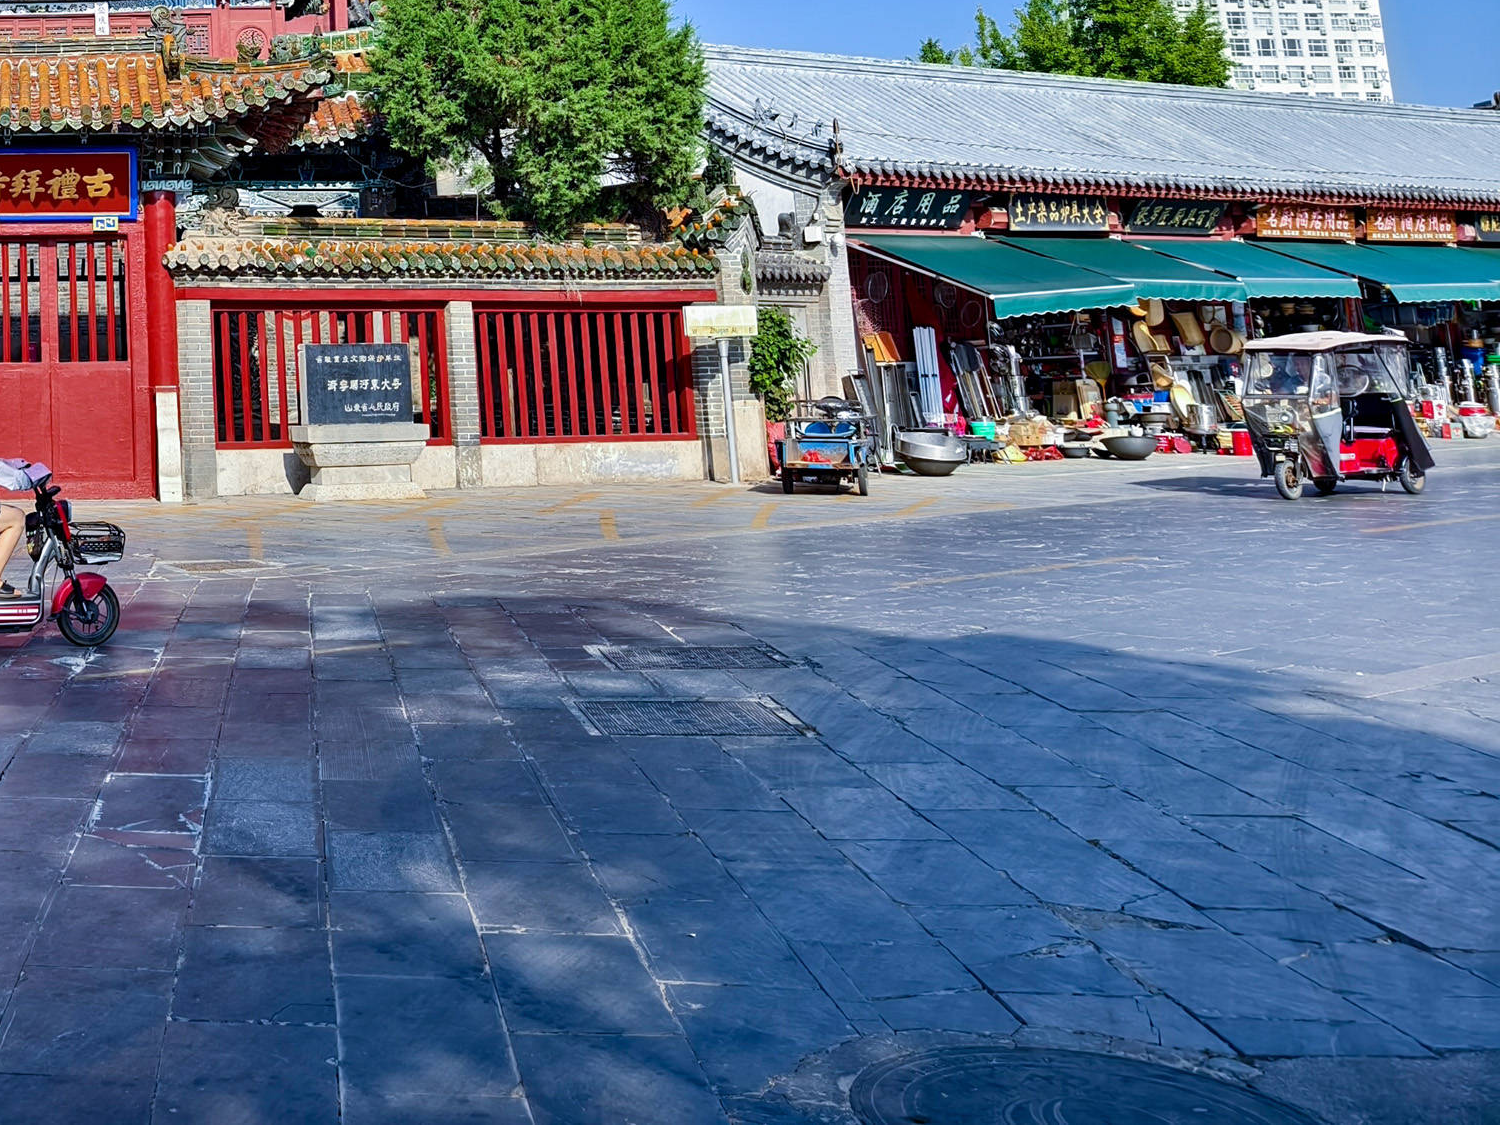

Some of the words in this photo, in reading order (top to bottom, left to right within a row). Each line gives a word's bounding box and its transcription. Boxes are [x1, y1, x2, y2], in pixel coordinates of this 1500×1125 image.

[859, 190, 962, 215] 酒店用品
[1266, 206, 1349, 230] 名厨酒店用品
[1374, 212, 1452, 233] 名厨酒店用品
